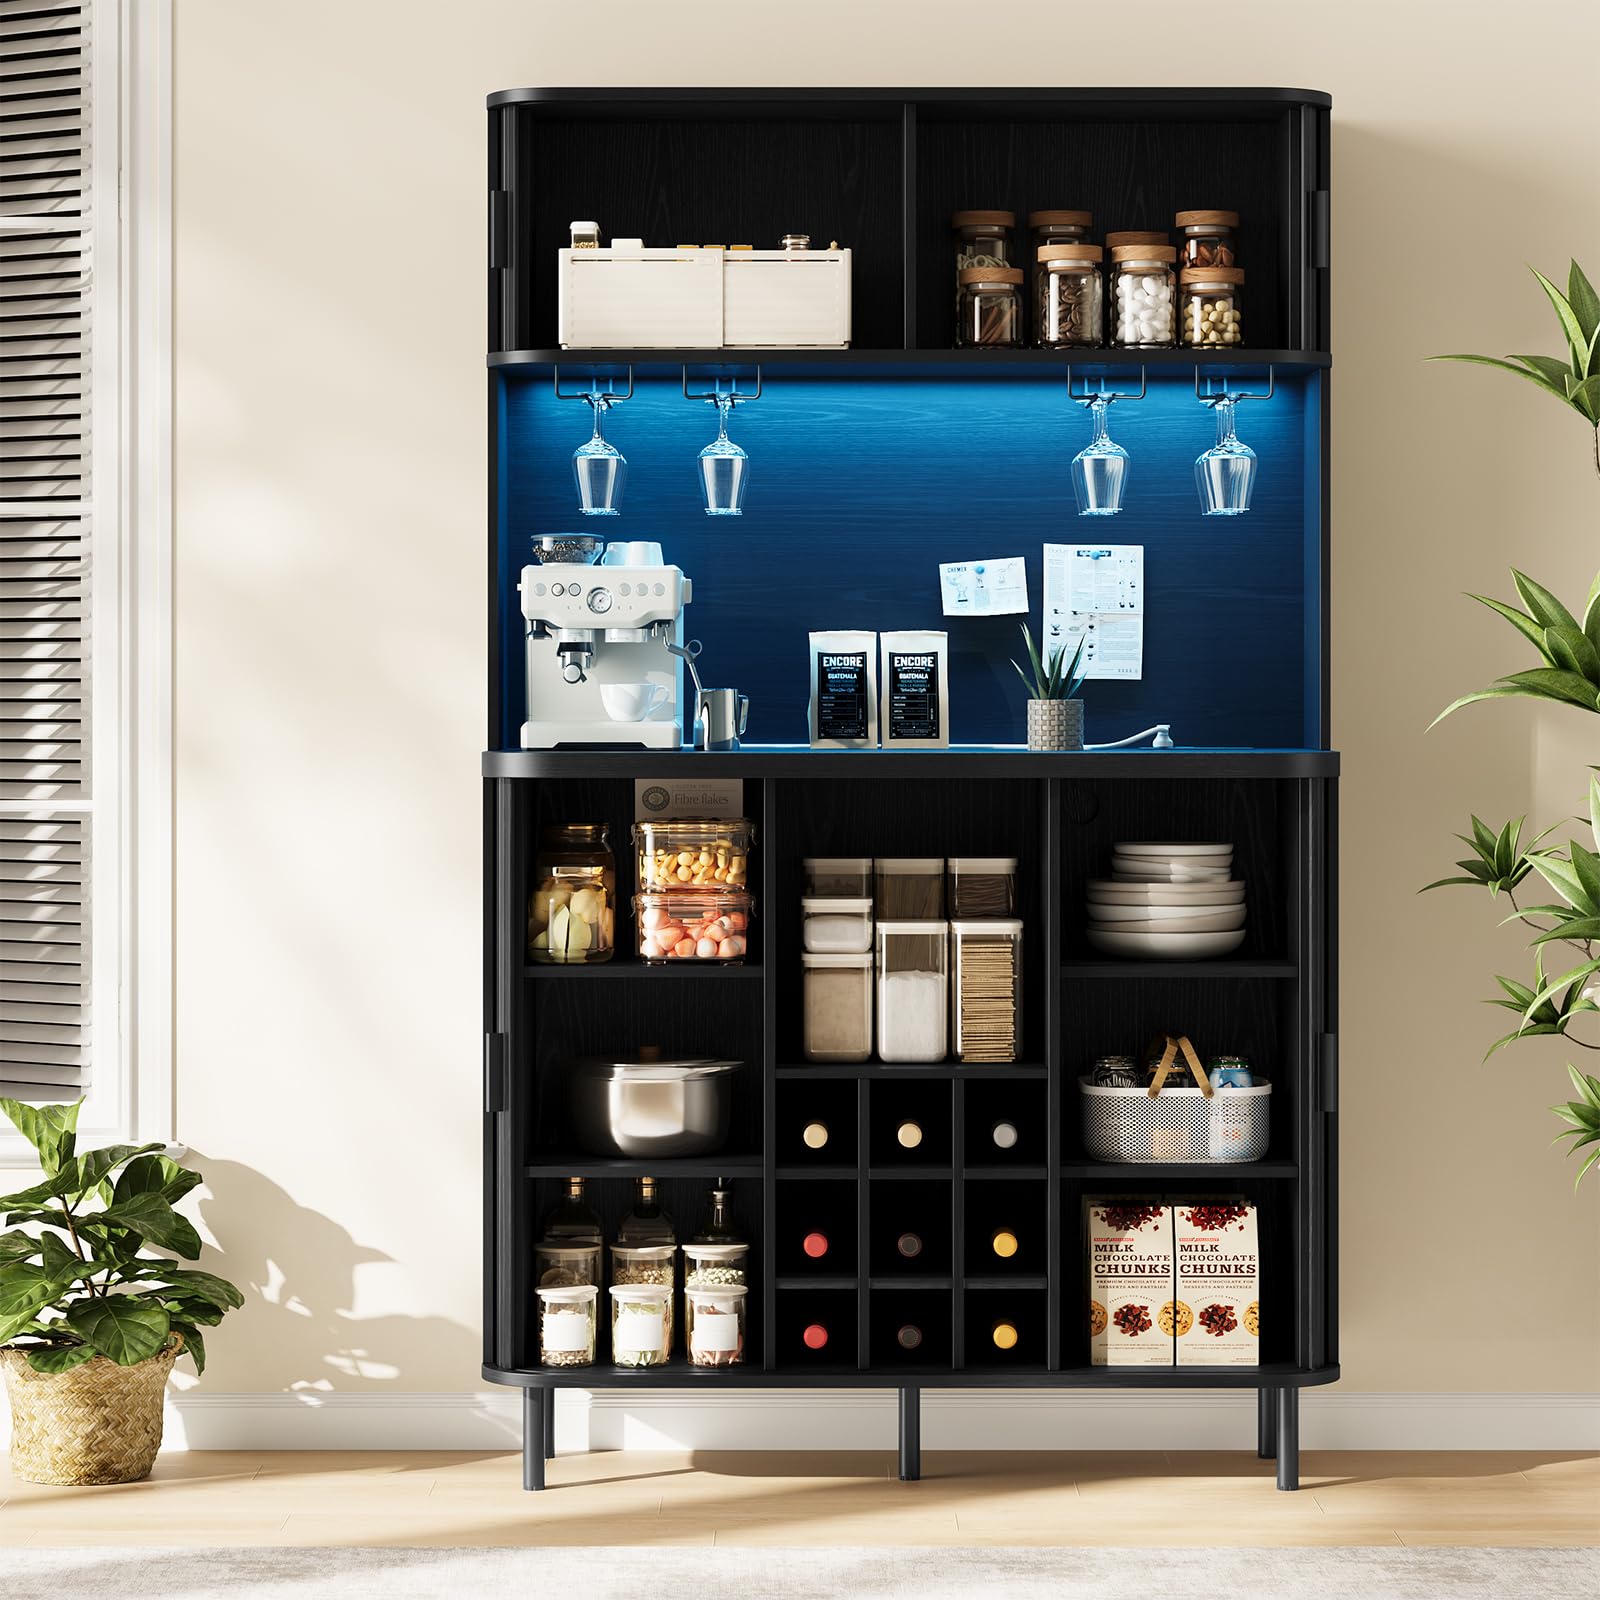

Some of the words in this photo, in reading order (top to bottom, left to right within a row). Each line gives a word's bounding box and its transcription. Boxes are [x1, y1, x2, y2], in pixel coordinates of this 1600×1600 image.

[823, 656, 863, 667] ENCORE
[894, 656, 934, 667] ENCORE
[674, 793, 699, 805] Fibre
[701, 793, 729, 805] flakes
[1094, 1244, 1134, 1252] MILK
[1180, 1244, 1220, 1252] MILK
[1094, 1264, 1171, 1274] CHUNKS
[1180, 1264, 1256, 1274] CHUNKS
